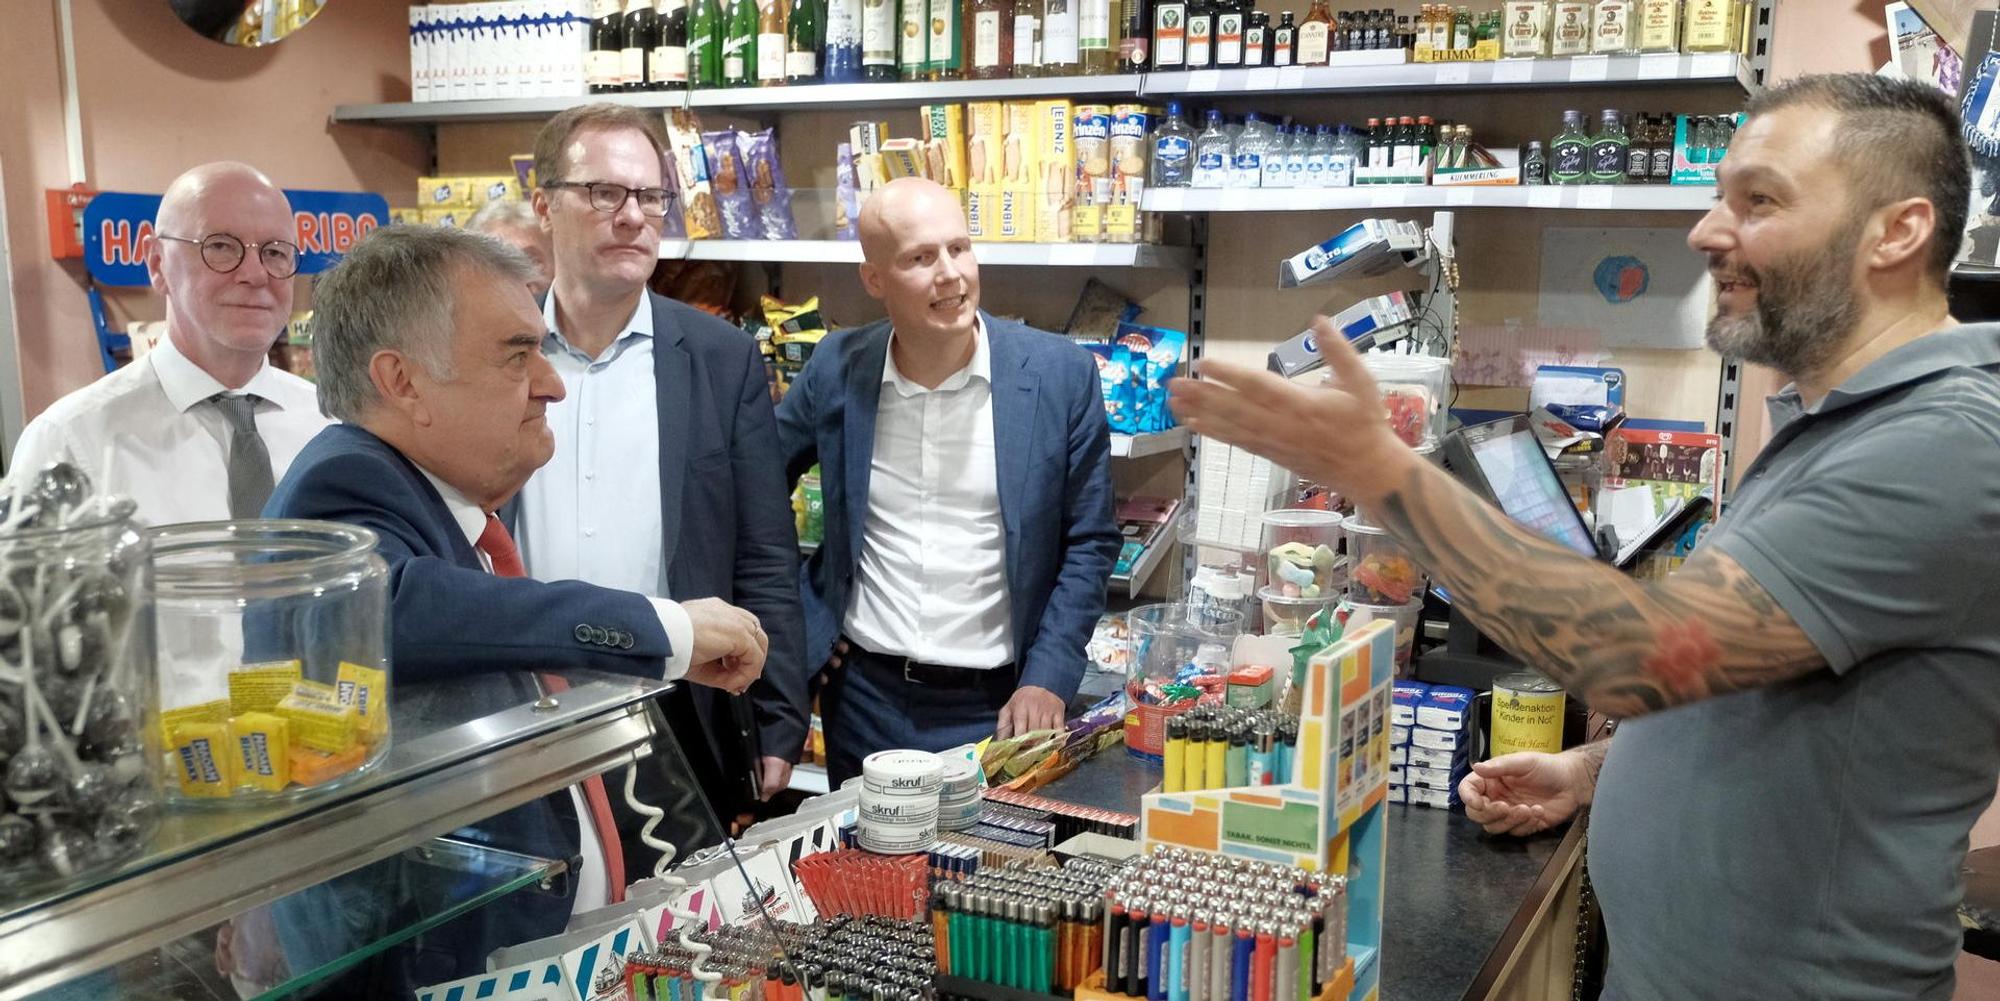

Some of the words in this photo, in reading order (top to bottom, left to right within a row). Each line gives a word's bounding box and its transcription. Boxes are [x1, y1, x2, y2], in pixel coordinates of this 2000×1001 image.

[1432, 50, 1476, 61] FLIMM
[1450, 171, 1500, 182] KUEMMERLING
[1526, 715, 1536, 725] in
[891, 775, 922, 788] skruf
[871, 803, 900, 817] skruf
